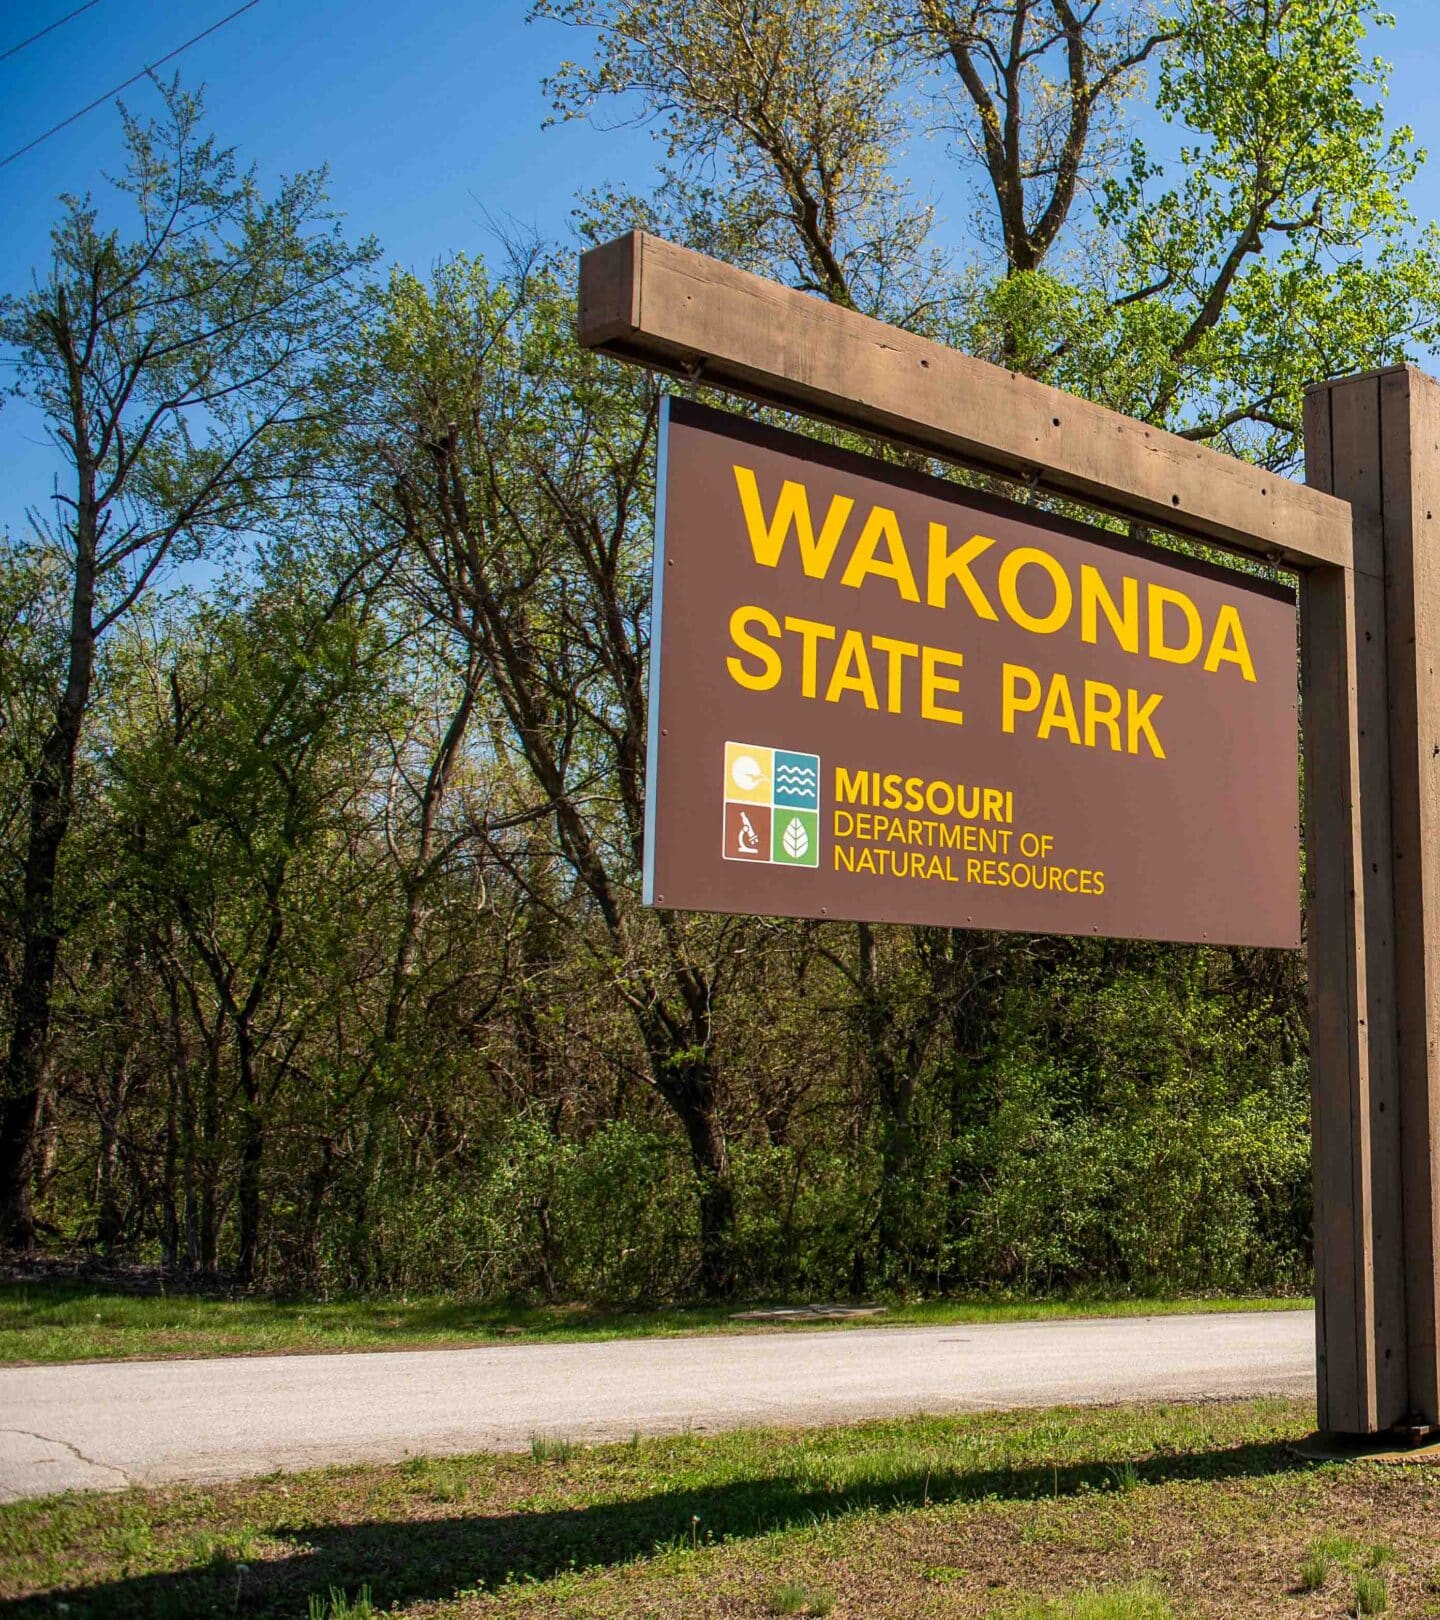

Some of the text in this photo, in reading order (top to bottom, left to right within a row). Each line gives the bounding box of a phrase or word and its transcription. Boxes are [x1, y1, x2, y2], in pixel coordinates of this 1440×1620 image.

[733, 465, 1257, 682] WAKONDA
[726, 606, 1167, 760] STATE PARK
[835, 767, 1013, 824] MISSOURI
[834, 810, 1054, 858] DEPARTMENT OF
[834, 845, 1105, 895] NATURAL RESOURCES
